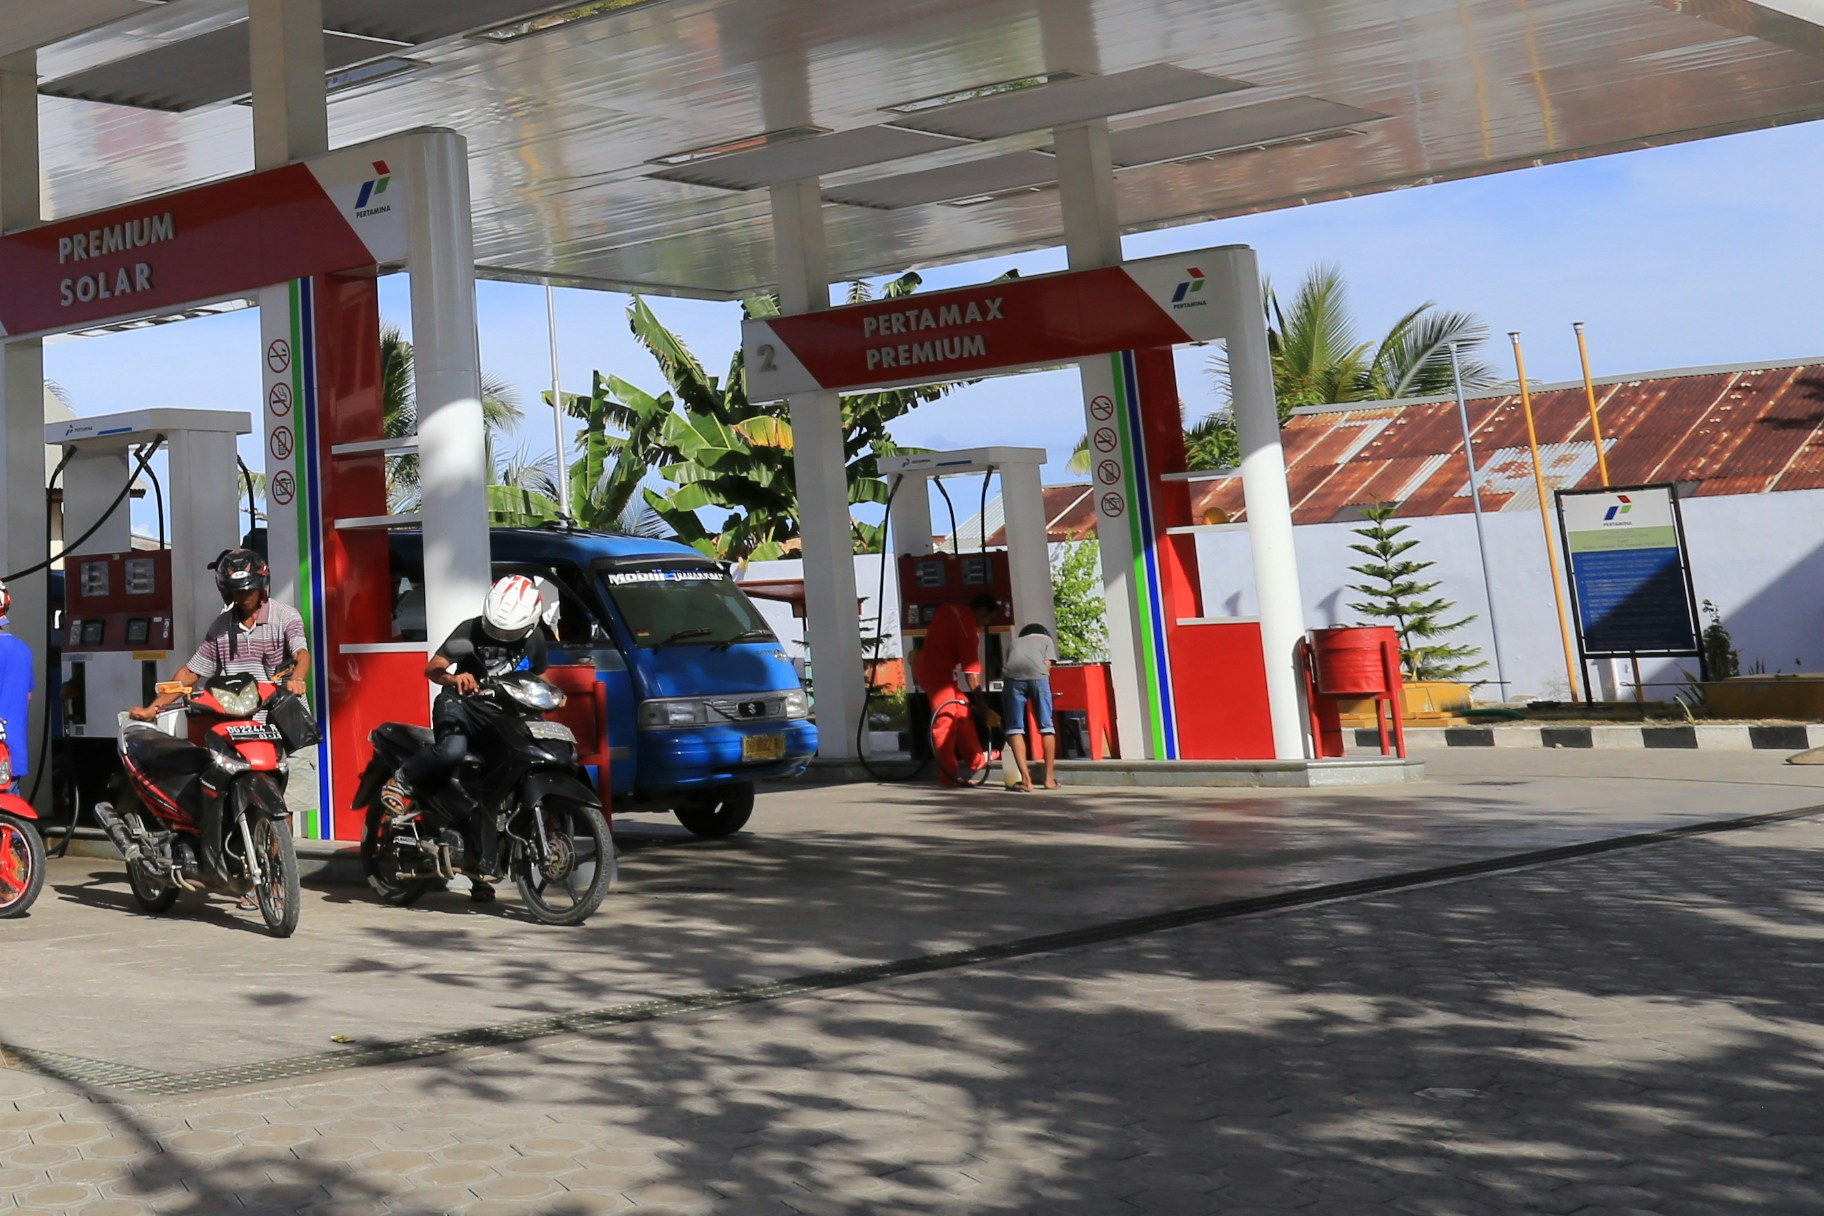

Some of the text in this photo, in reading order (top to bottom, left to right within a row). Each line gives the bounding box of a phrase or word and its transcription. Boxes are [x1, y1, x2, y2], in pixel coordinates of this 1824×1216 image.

[356, 204, 391, 219] PERTAMINA
[59, 212, 175, 265] PREMIUM
[60, 262, 154, 307] SOLAR
[863, 297, 1004, 338] PERTAMAX
[1173, 300, 1207, 309] PERTAMINA
[756, 343, 777, 373] 2
[866, 334, 987, 371] PREMIUM
